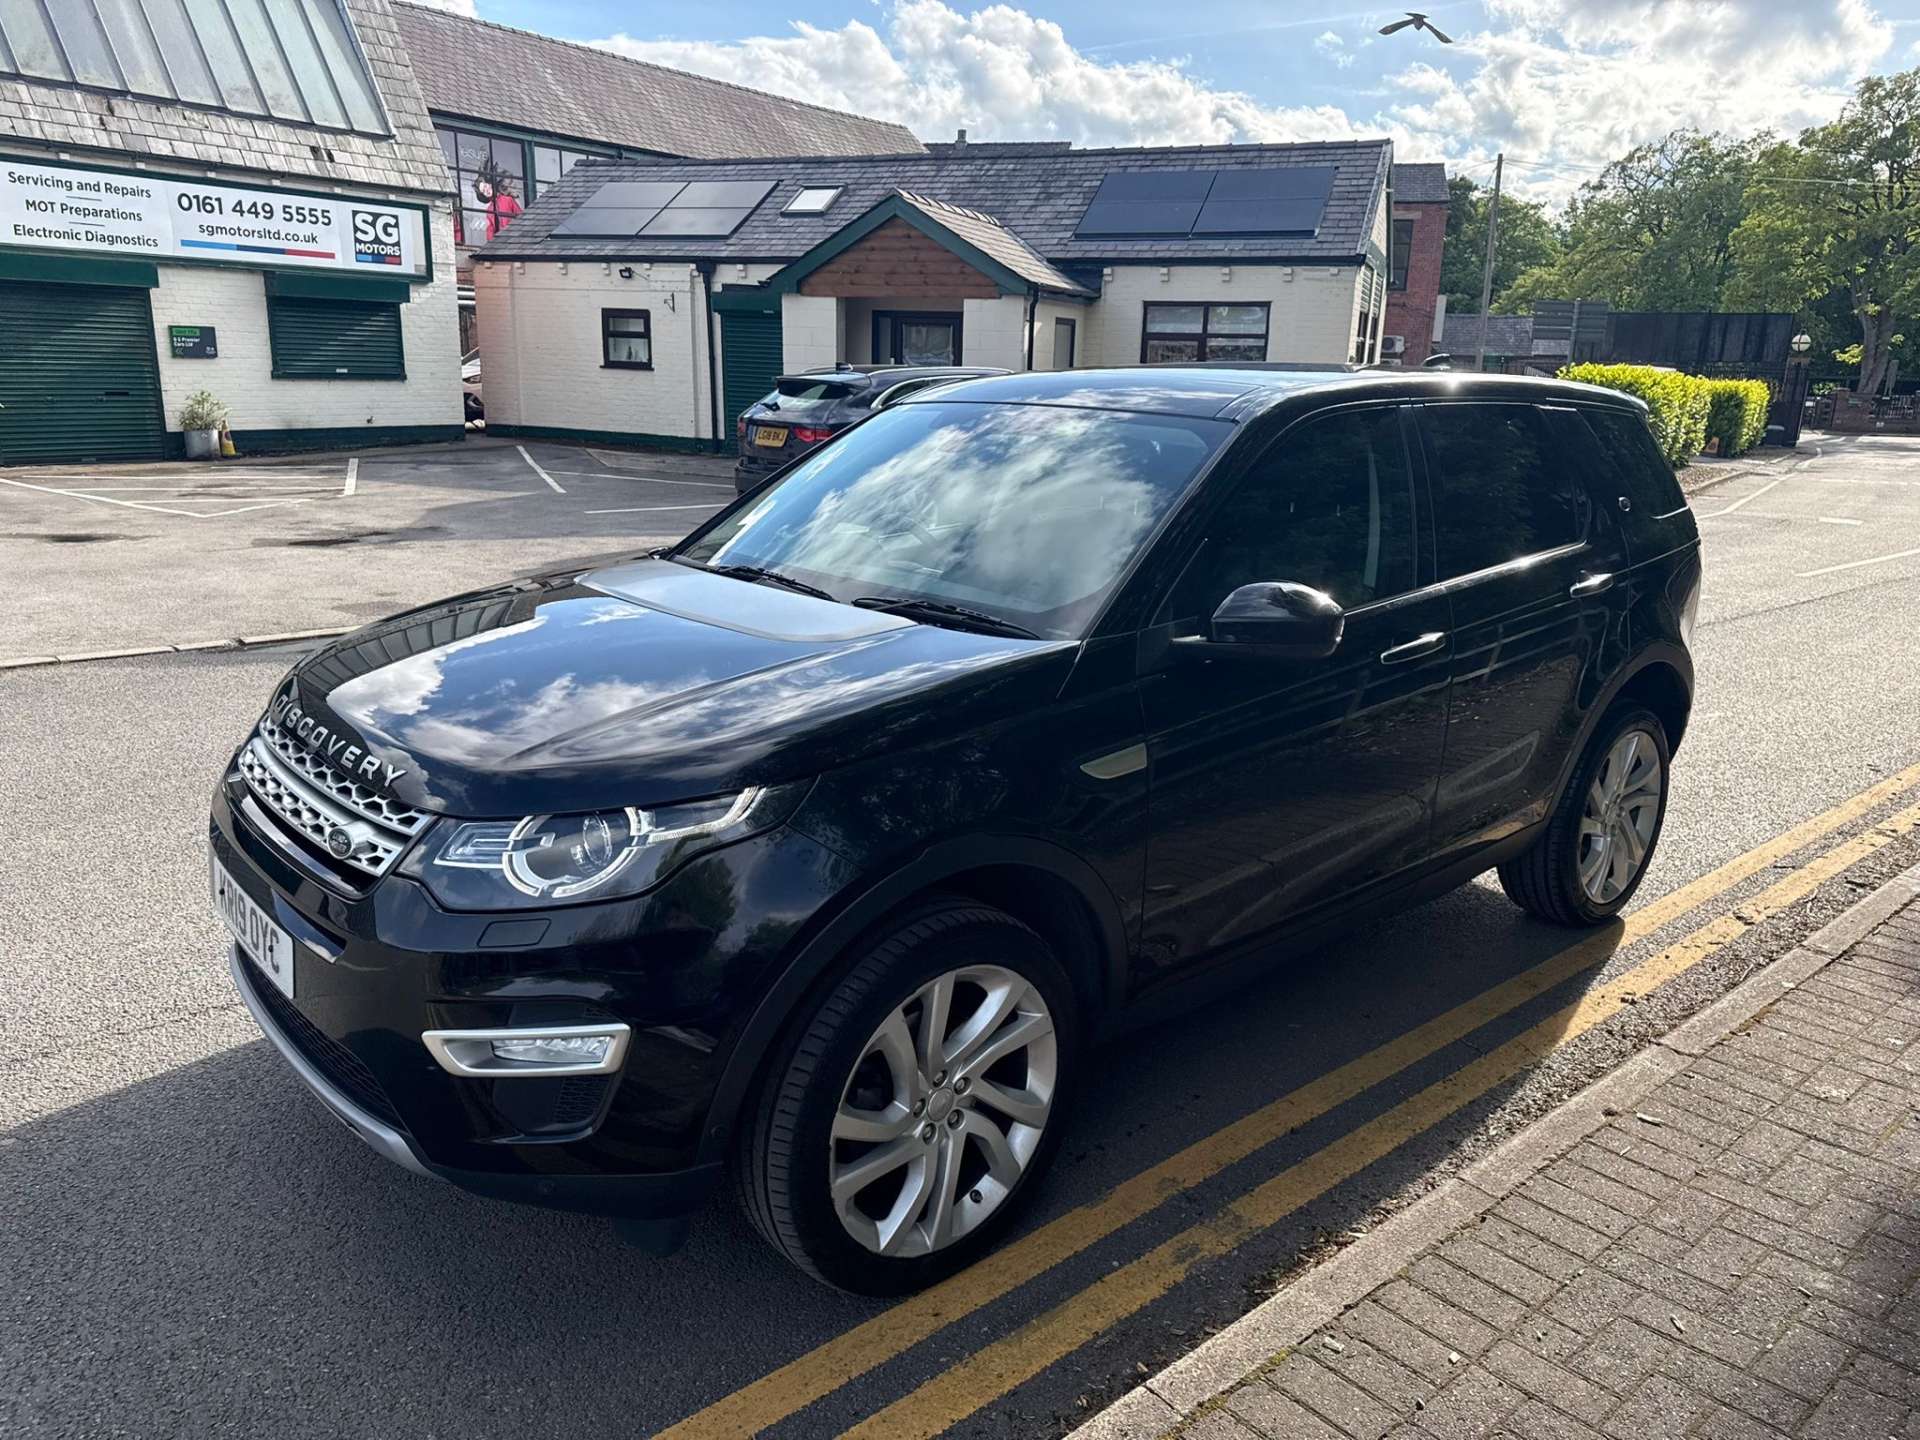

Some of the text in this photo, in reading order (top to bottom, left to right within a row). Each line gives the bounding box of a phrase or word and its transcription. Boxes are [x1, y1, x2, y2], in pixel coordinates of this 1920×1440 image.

[8, 171, 152, 198] Servicing and Repairs
[25, 199, 143, 221] MOT Preparations
[177, 192, 332, 226] 0161 449 5555
[13, 224, 159, 247] Electronic Diagnostics
[198, 224, 318, 244] sgmotorsltd.co.uk
[354, 212, 399, 244] SG
[356, 243, 400, 255] MOTORS
[273, 694, 408, 787] DISCOVERY
[219, 867, 280, 974] KR19 OYC
